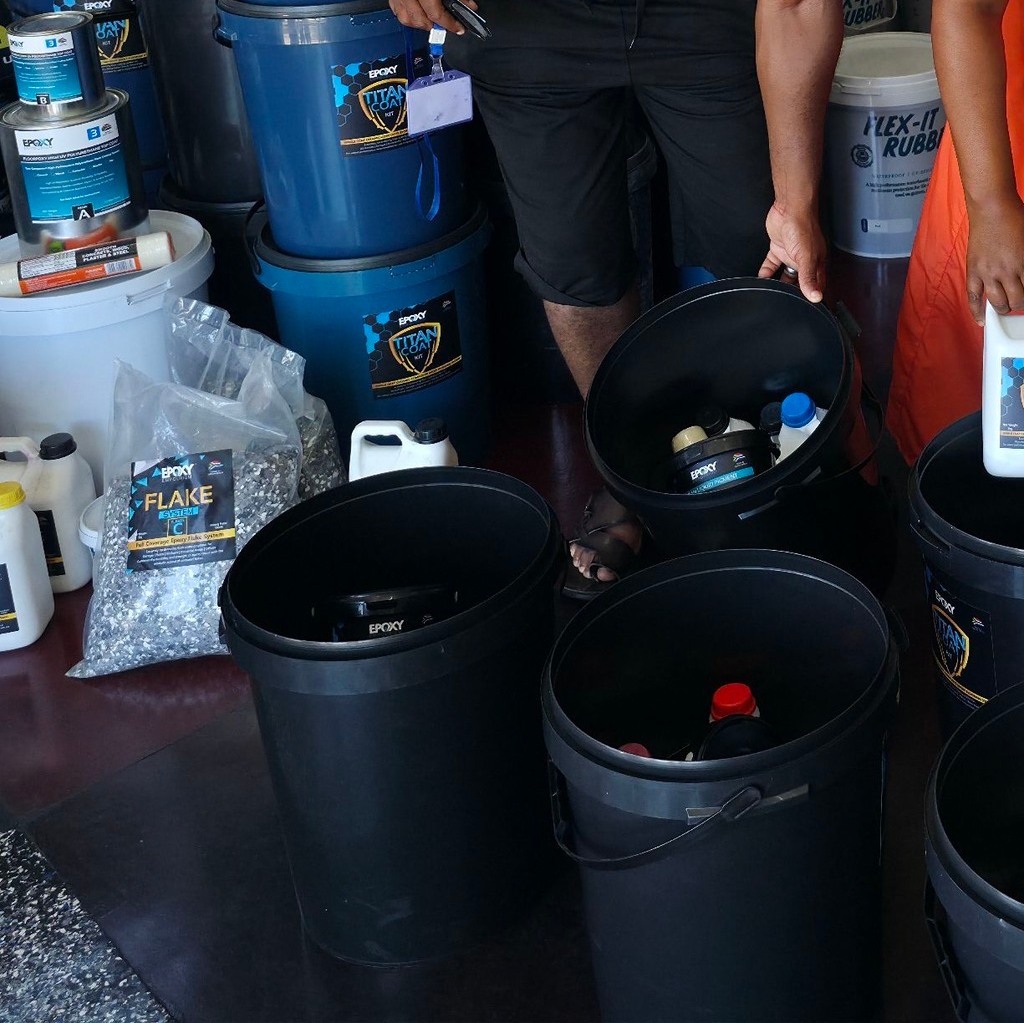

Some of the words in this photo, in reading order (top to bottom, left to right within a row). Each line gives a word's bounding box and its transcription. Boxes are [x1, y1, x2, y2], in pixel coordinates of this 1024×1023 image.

[84, 0, 113, 10] EPOXY
[844, 0, 885, 27] UBBER
[96, 29, 121, 39] OAT
[48, 39, 55, 47] 3
[368, 65, 398, 78] EPOXY
[363, 84, 408, 104] TITAN
[371, 96, 404, 112] COAT
[863, 107, 940, 137] FLEX-IT
[90, 128, 98, 138] 3
[22, 137, 54, 147] EPOXY
[79, 209, 91, 220] A
[83, 254, 106, 262] PLASTER
[113, 249, 130, 257] STEEL
[398, 310, 427, 326] EPOXY
[393, 325, 437, 350] TITAN
[401, 338, 432, 356] COAT
[161, 463, 194, 479] EPOXY
[690, 461, 718, 480] EPOXY
[144, 485, 214, 512] FLAKE
[163, 507, 194, 518] SYSTEM
[173, 522, 183, 535] C
[145, 538, 170, 547] Coverage
[203, 532, 225, 540] System
[368, 620, 405, 634] EPOXY
